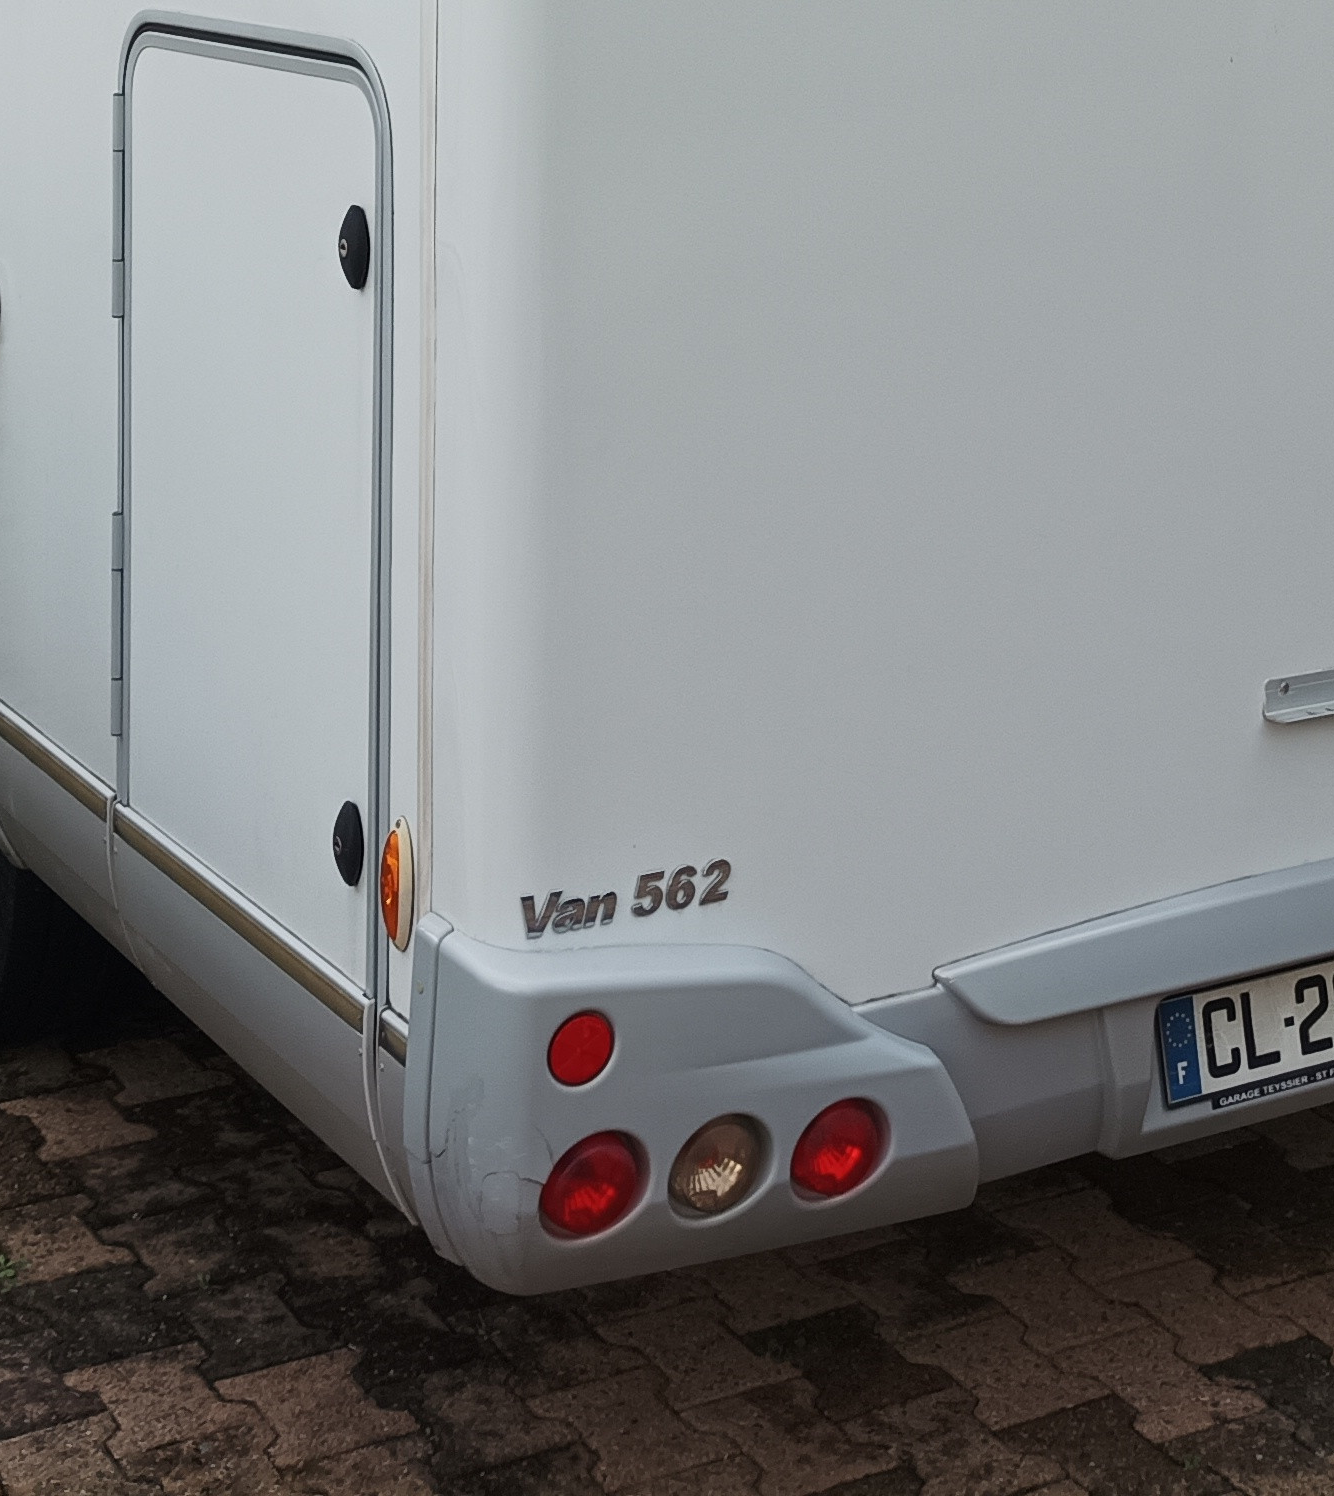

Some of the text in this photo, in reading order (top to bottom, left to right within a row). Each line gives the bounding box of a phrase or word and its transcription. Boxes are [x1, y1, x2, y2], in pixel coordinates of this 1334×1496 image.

[520, 858, 732, 940] Van 562
[1176, 1060, 1189, 1085] F
[1219, 1087, 1261, 1106] GARAGE
[1262, 1075, 1309, 1095] TEYSSIER
[1315, 1069, 1328, 1081] ST
